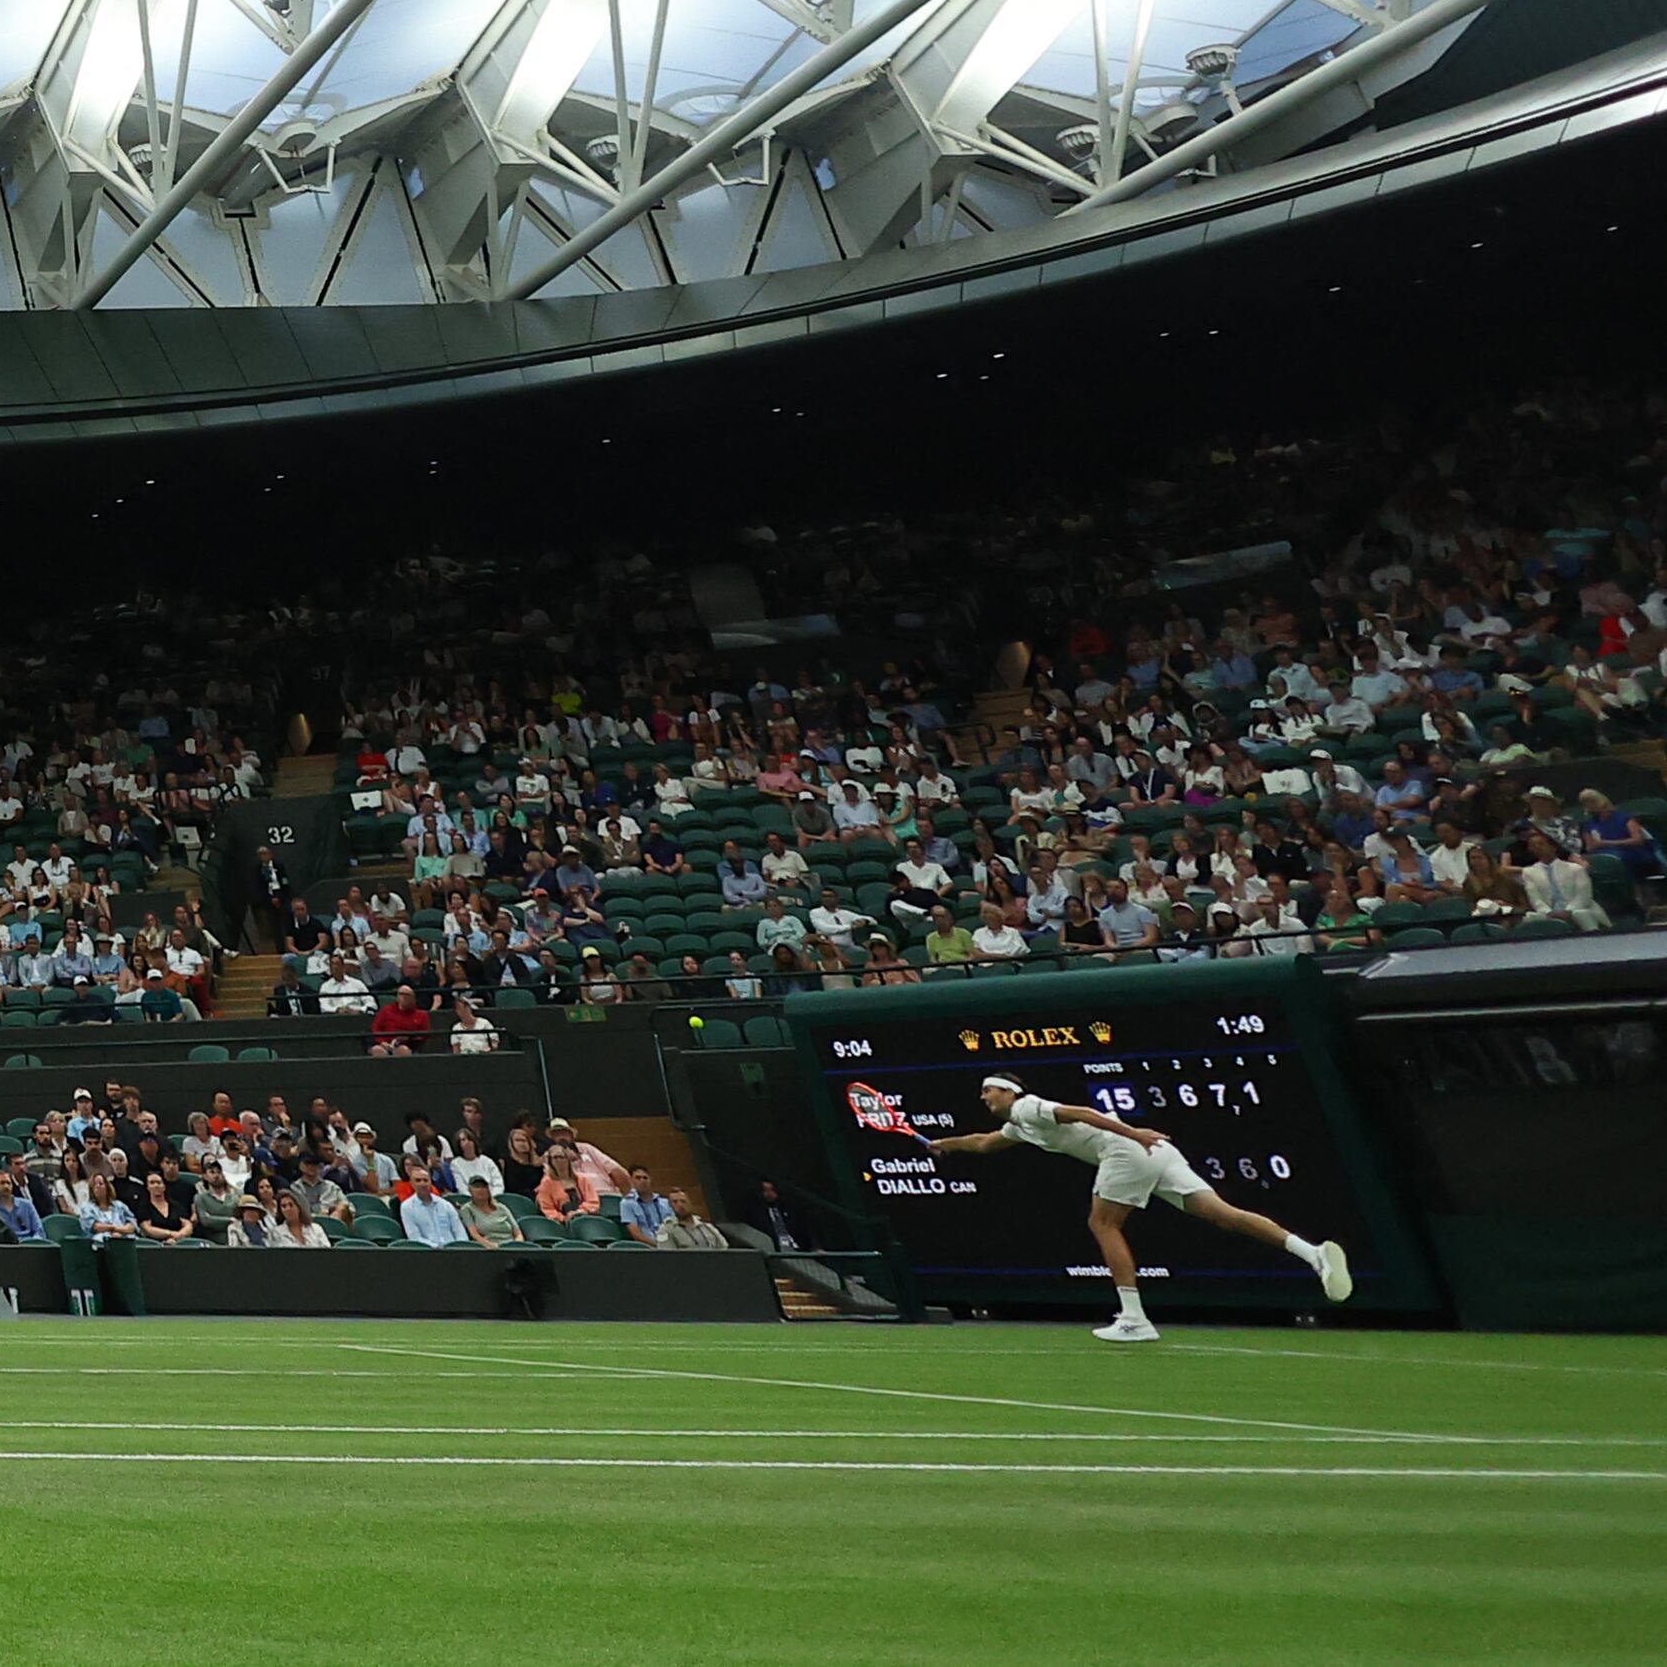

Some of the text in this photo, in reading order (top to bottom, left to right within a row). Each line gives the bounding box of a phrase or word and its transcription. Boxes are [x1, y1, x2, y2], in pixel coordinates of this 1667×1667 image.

[267, 826, 295, 844] 32
[1216, 1015, 1265, 1035] 1:49
[991, 1026, 1081, 1049] ROLEX
[833, 1039, 873, 1058] 9:04
[1083, 1054, 1277, 1074] POINTS 1 2 3 4 5
[911, 1114, 938, 1126] USA
[937, 1113, 955, 1129] (5)
[1095, 1087, 1136, 1111] 15
[1147, 1085, 1167, 1108] 3
[1178, 1083, 1199, 1107] 6
[1208, 1083, 1226, 1107] 7
[1232, 1105, 1241, 1116] 7
[1242, 1081, 1260, 1105] 1
[871, 1157, 936, 1174] Gabriel
[877, 1178, 946, 1194] DIALLO
[949, 1181, 977, 1194] CAN
[1205, 1157, 1226, 1180] 3
[1238, 1157, 1259, 1180] 6
[1269, 1154, 1291, 1179] 0
[1065, 1264, 1171, 1277] wimble.com
